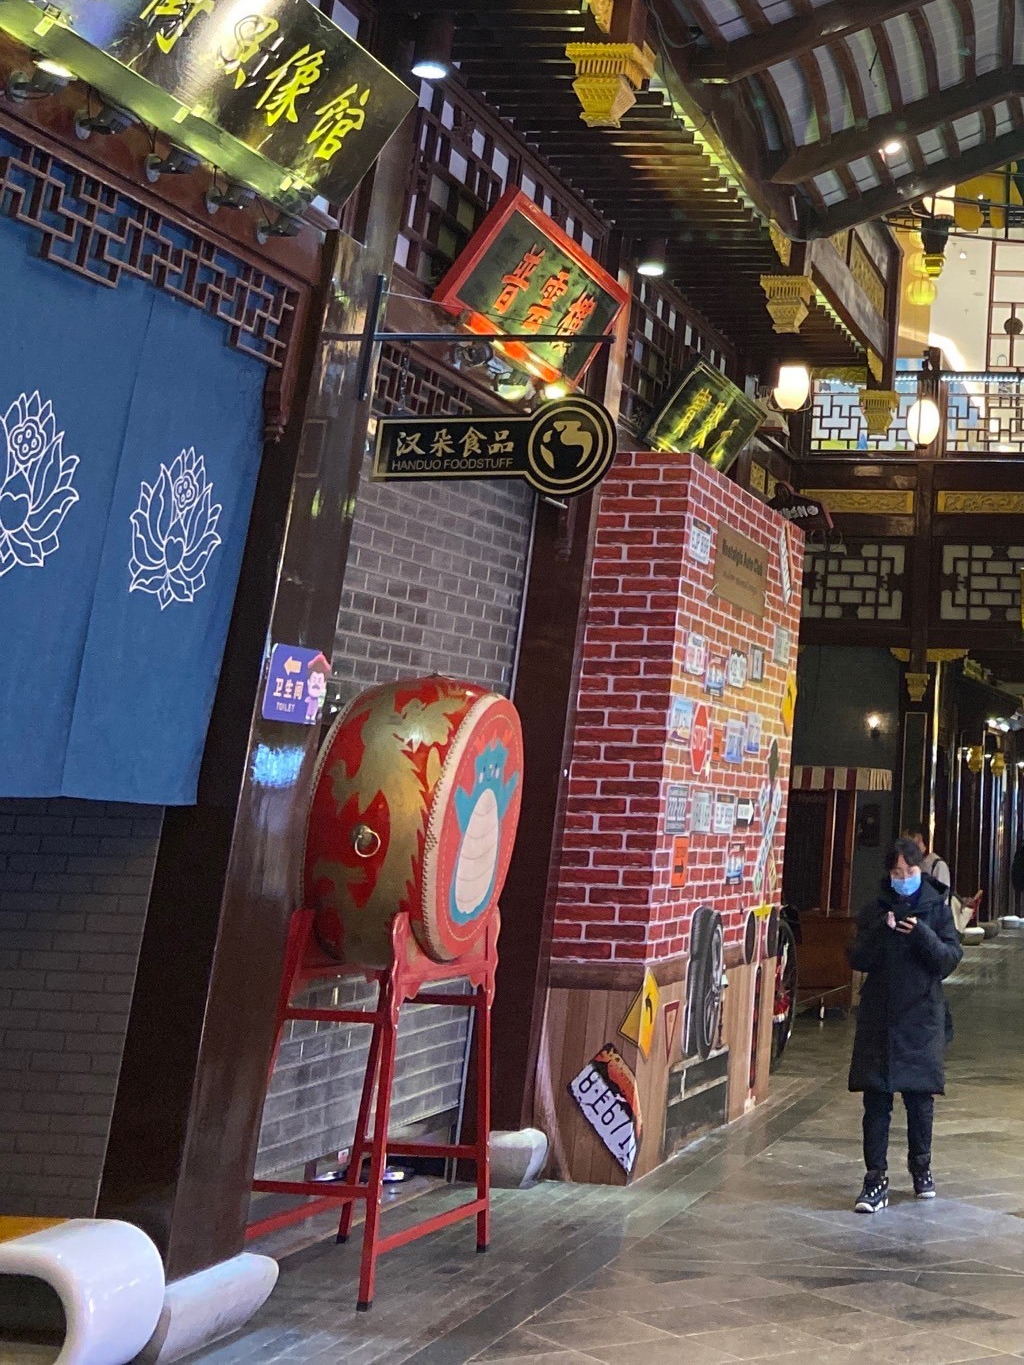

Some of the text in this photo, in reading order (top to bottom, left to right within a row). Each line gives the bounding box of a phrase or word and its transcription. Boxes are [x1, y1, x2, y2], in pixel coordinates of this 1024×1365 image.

[396, 426, 515, 457] 汉朵食品
[391, 457, 514, 471] HANDUO FOODSTUFF
[272, 677, 305, 701] 卫生间
[276, 701, 296, 713] TOILET
